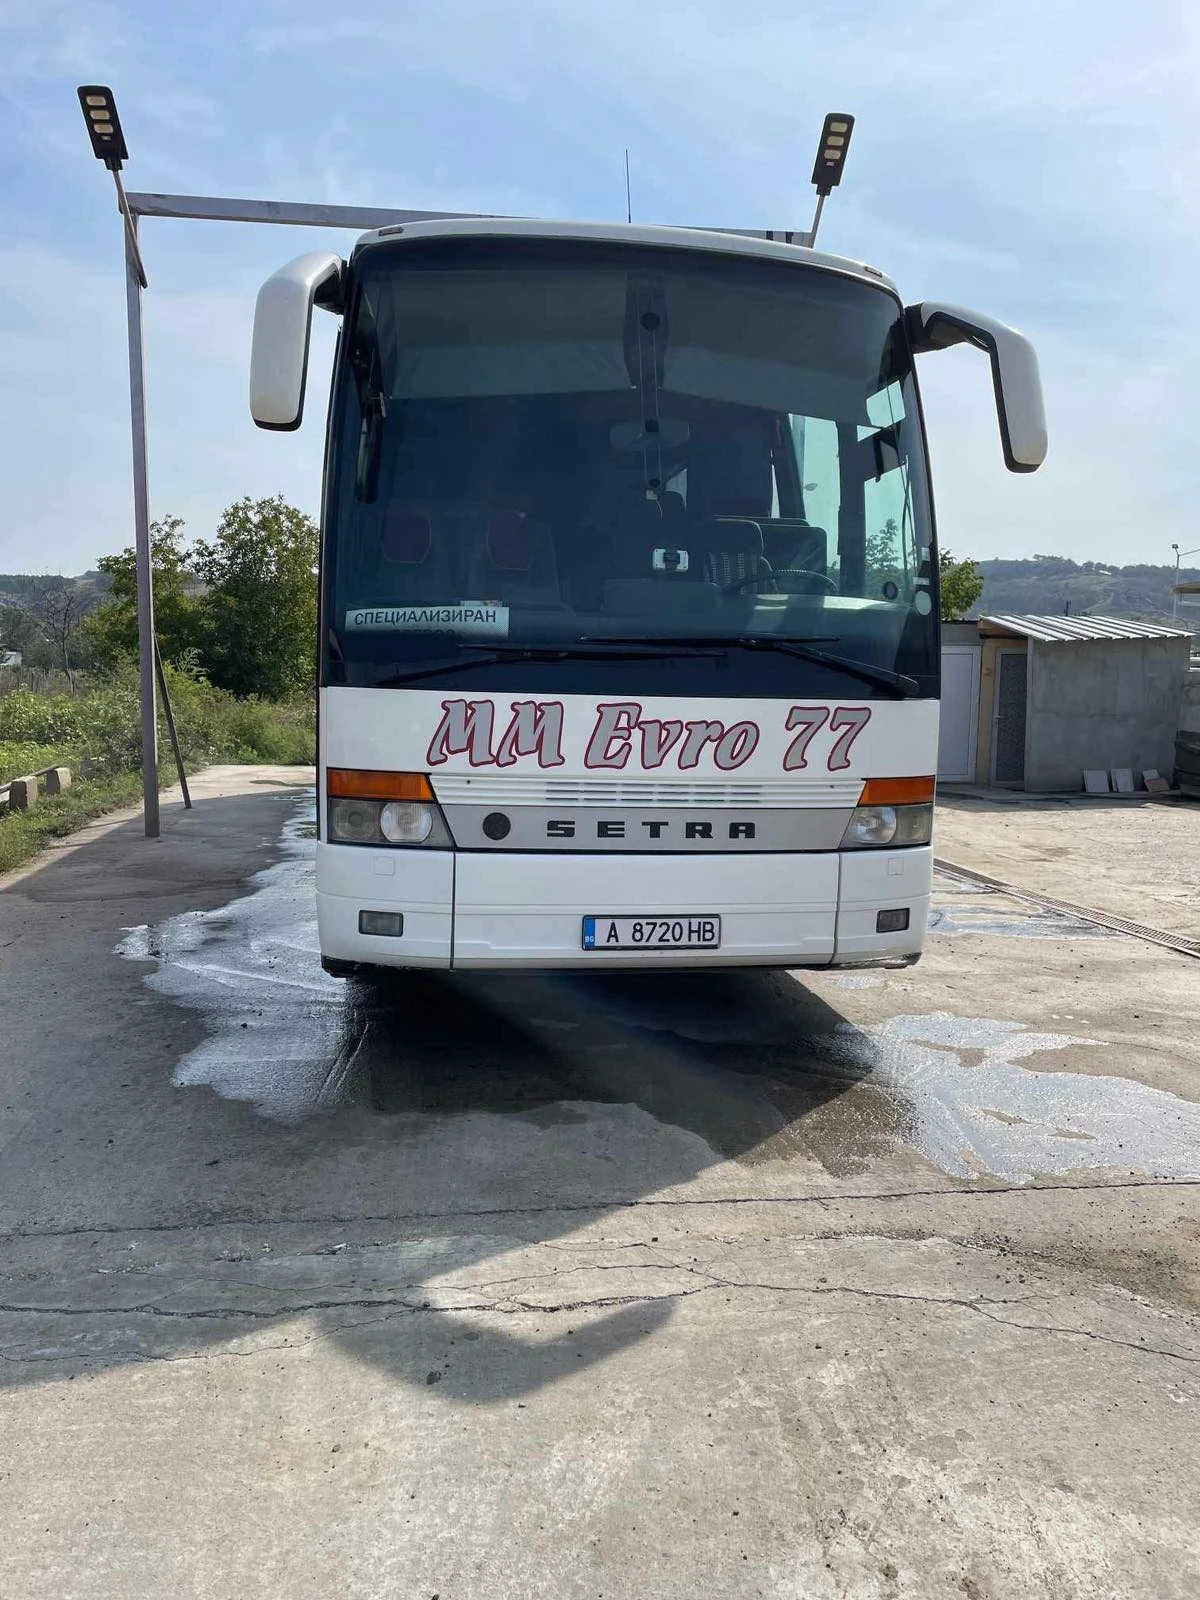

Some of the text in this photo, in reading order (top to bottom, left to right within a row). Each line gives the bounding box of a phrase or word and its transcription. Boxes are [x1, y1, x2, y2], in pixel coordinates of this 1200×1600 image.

[354, 609, 497, 625] СПЕЦИАЛИЗИРАН
[426, 699, 871, 771] MM Evro 77
[546, 820, 756, 839] SETRA
[584, 935, 595, 943] BG
[606, 921, 620, 943] A
